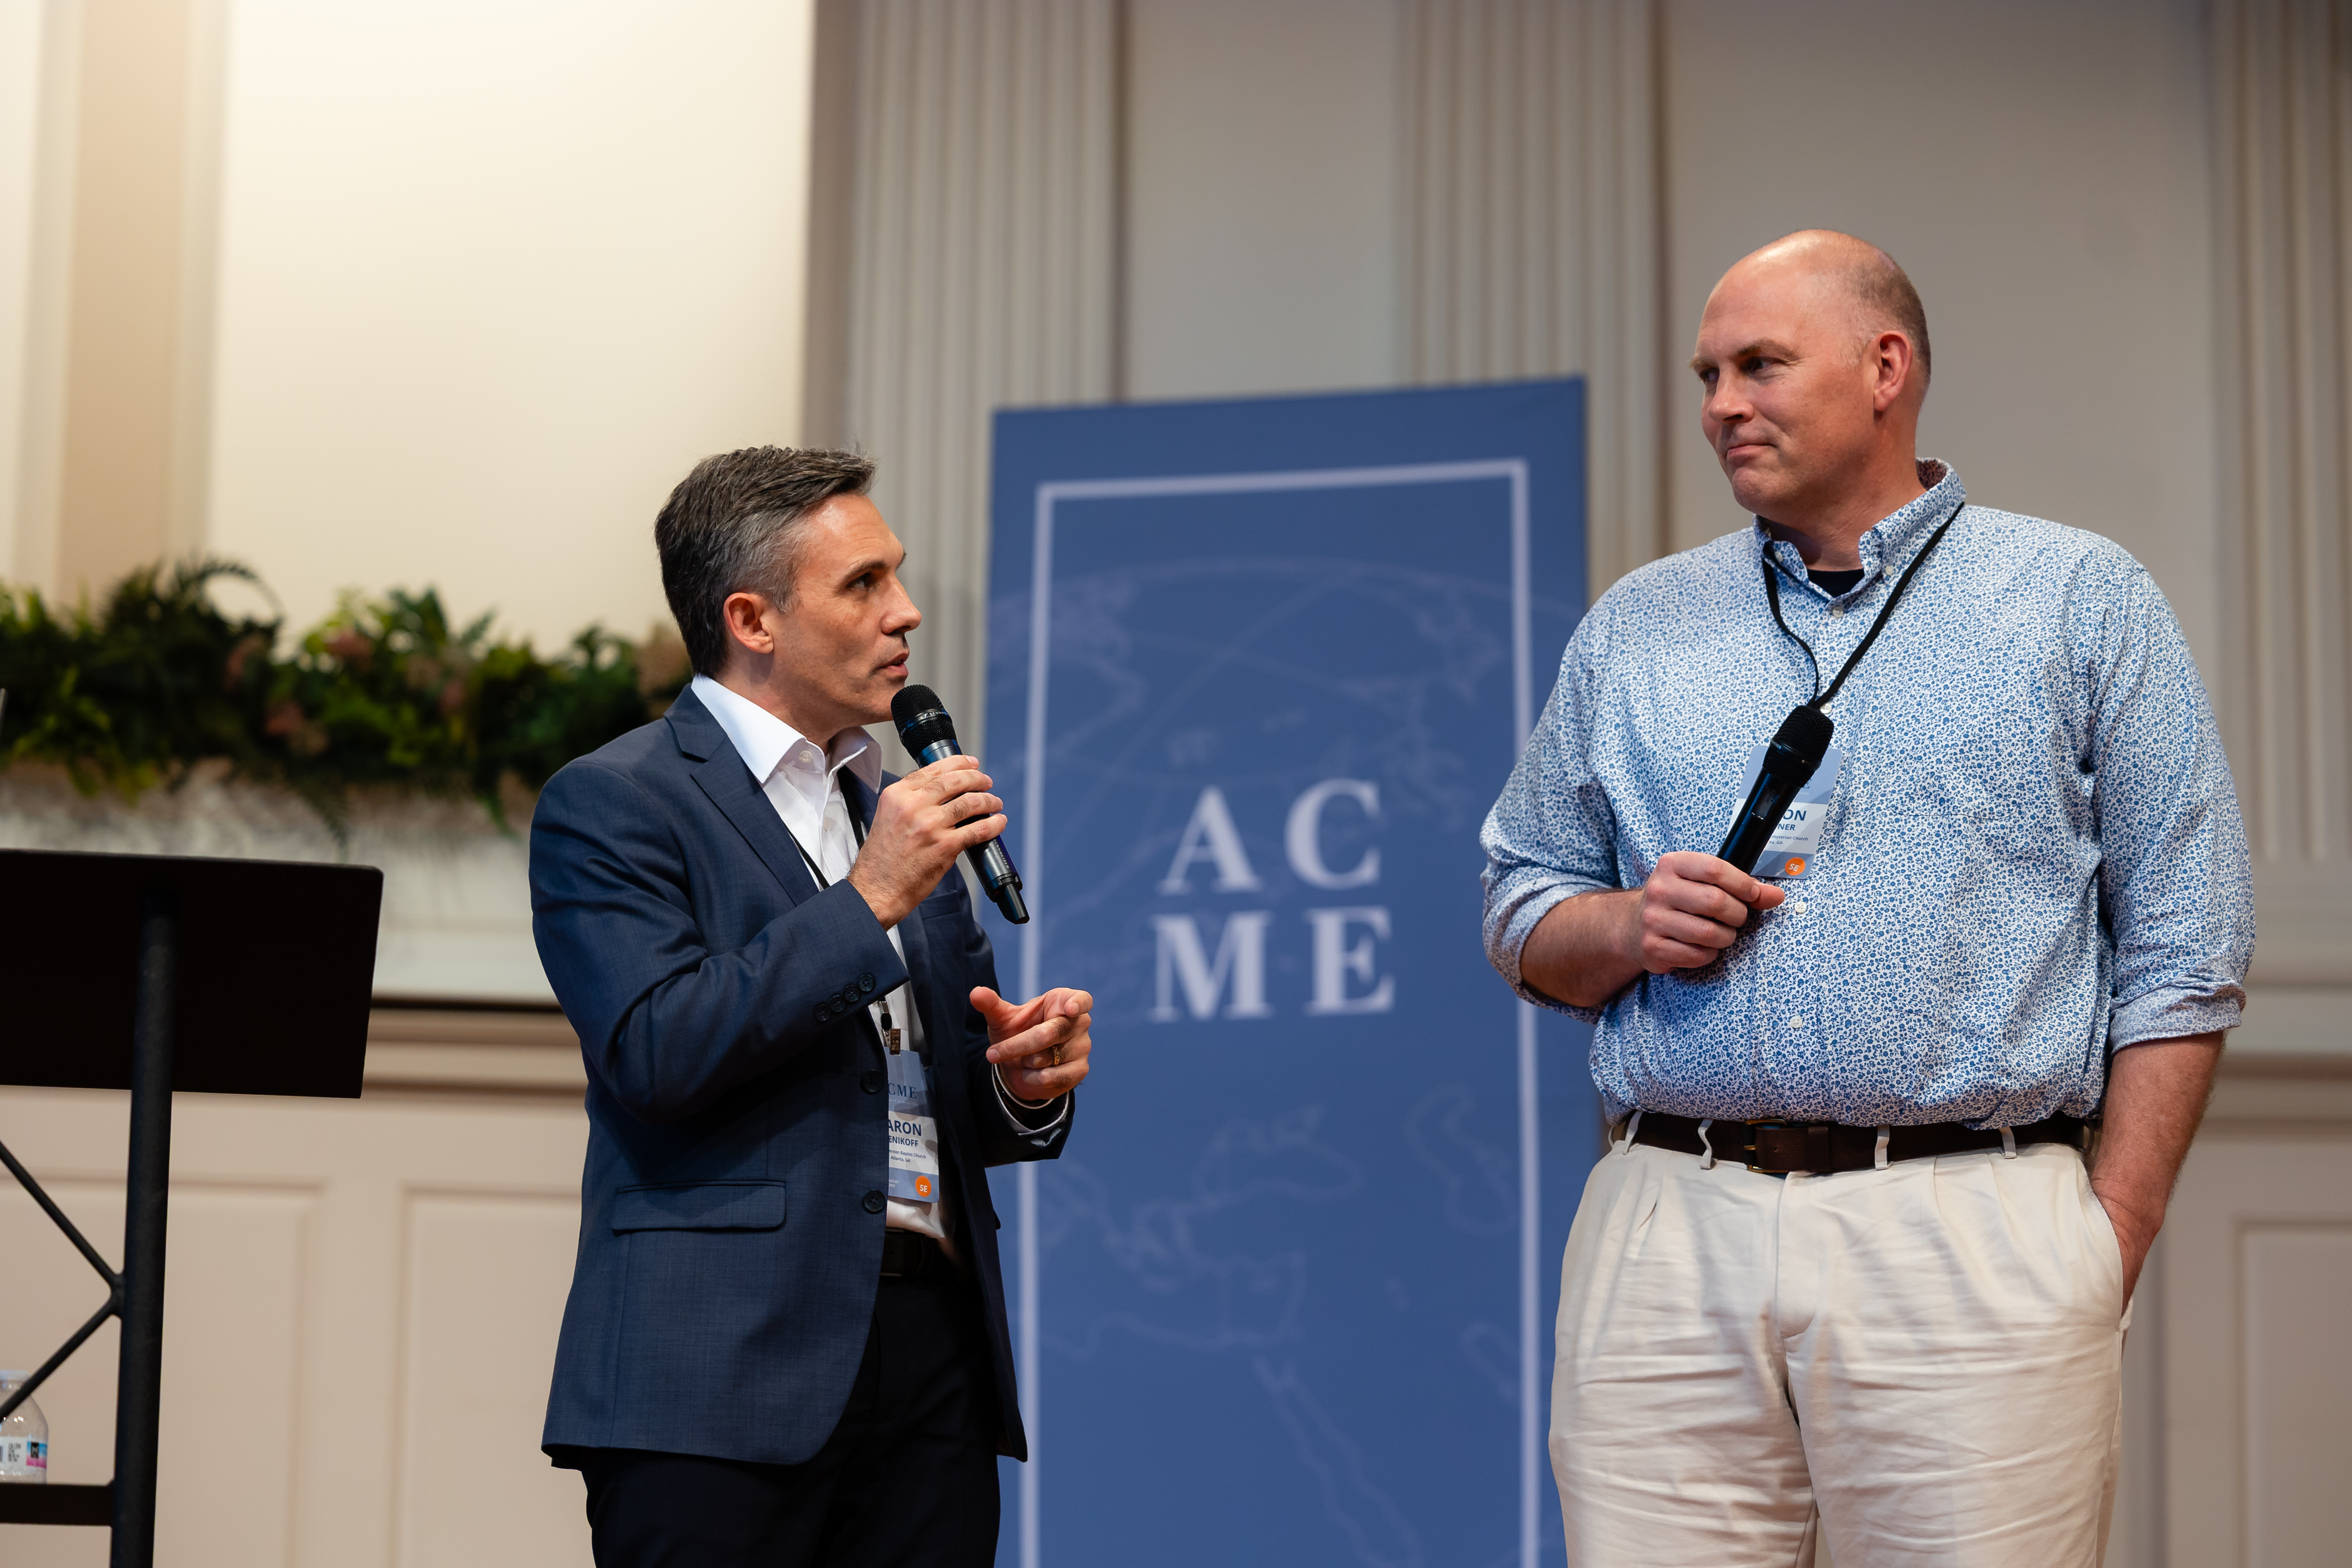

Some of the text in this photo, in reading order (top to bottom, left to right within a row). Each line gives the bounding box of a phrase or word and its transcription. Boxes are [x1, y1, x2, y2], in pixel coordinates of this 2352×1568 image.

[1783, 809, 1807, 821] ON
[1788, 863, 1800, 872] SE
[888, 1083, 916, 1099] CME
[888, 1119, 922, 1136] ARON
[889, 1135, 919, 1147] ENIKOFF
[919, 1184, 928, 1193] SE
